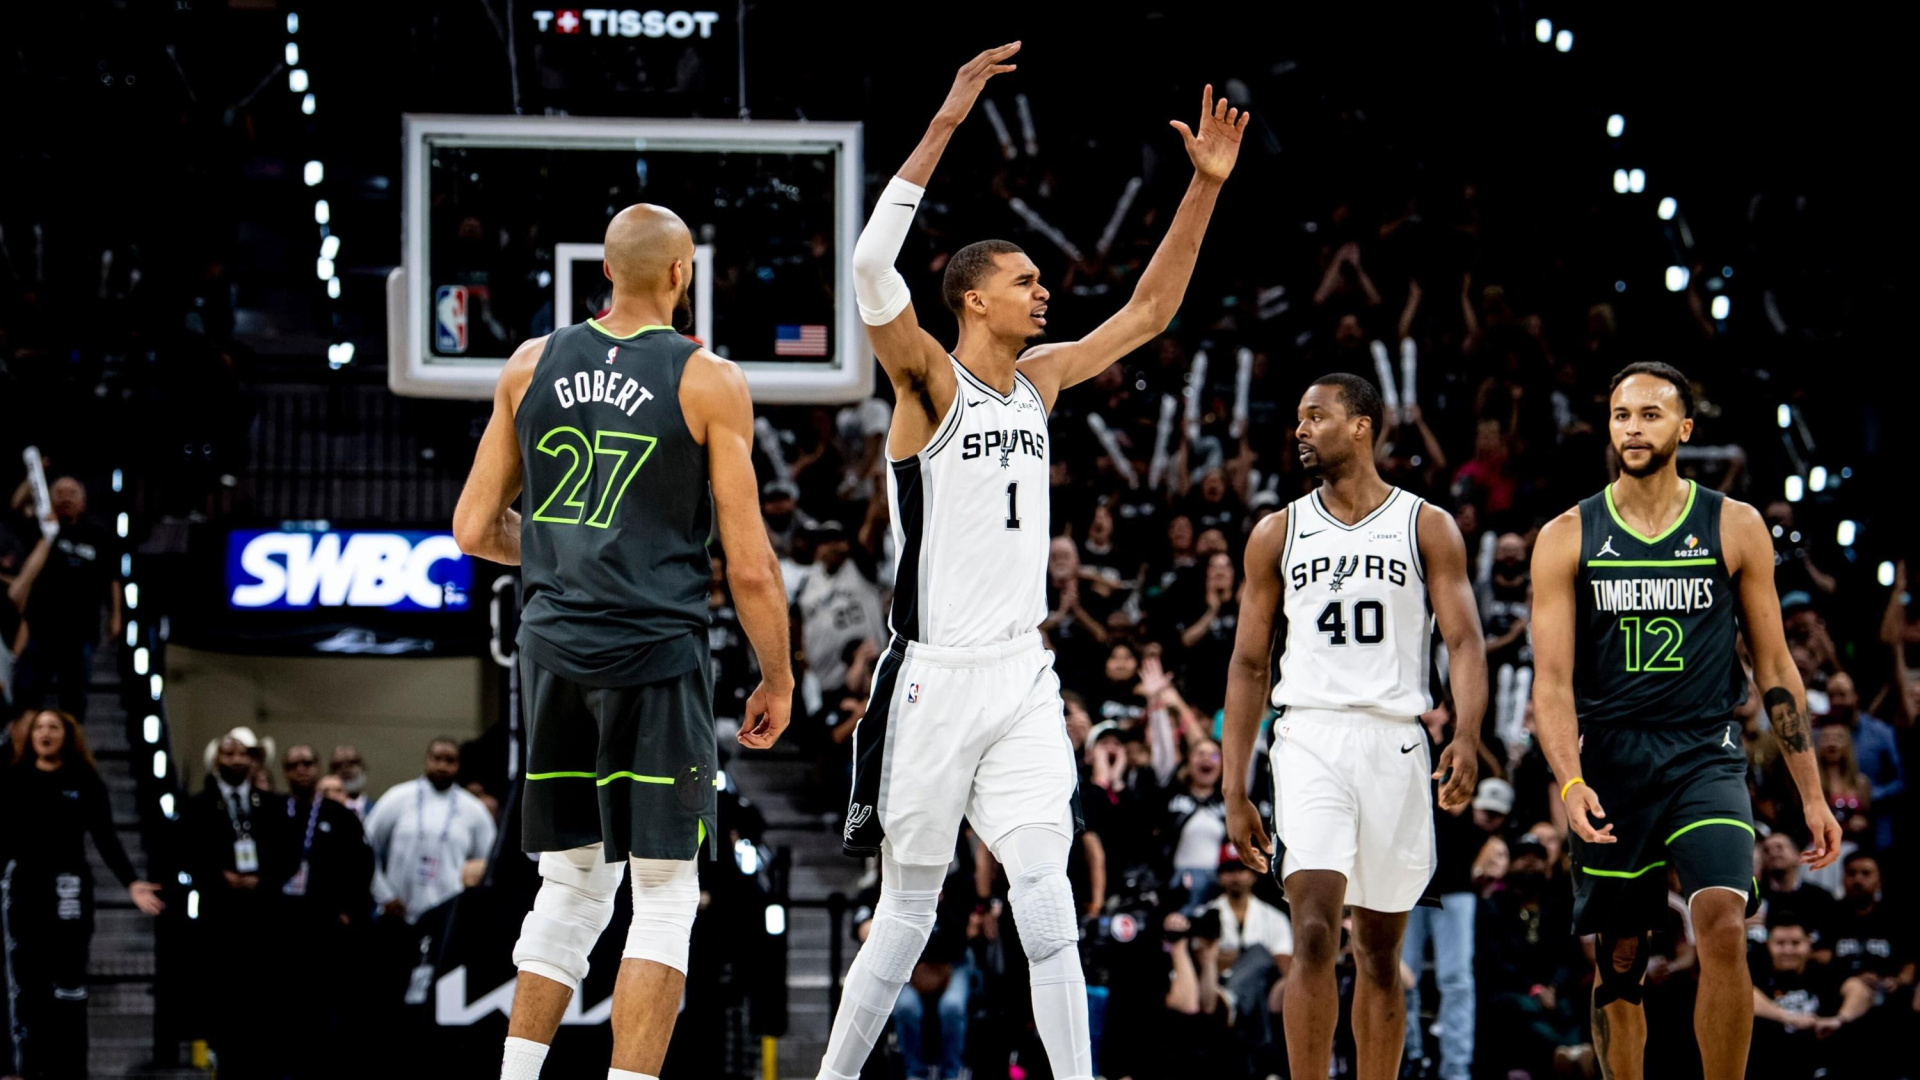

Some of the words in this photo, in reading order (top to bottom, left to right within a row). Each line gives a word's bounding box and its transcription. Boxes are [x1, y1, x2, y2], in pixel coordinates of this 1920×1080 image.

[582, 9, 719, 39] TISSOT
[554, 370, 655, 417] GOBERT
[962, 429, 1044, 470] SPURS
[533, 426, 657, 529] 27
[1005, 480, 1021, 531] 1
[231, 532, 463, 609] SWBC
[1291, 554, 1407, 593] SPURS
[1674, 547, 1709, 557] sezzle
[1591, 577, 1714, 616] TIMBERWOLVES
[1315, 598, 1387, 647] 40
[1620, 616, 1684, 672] 12
